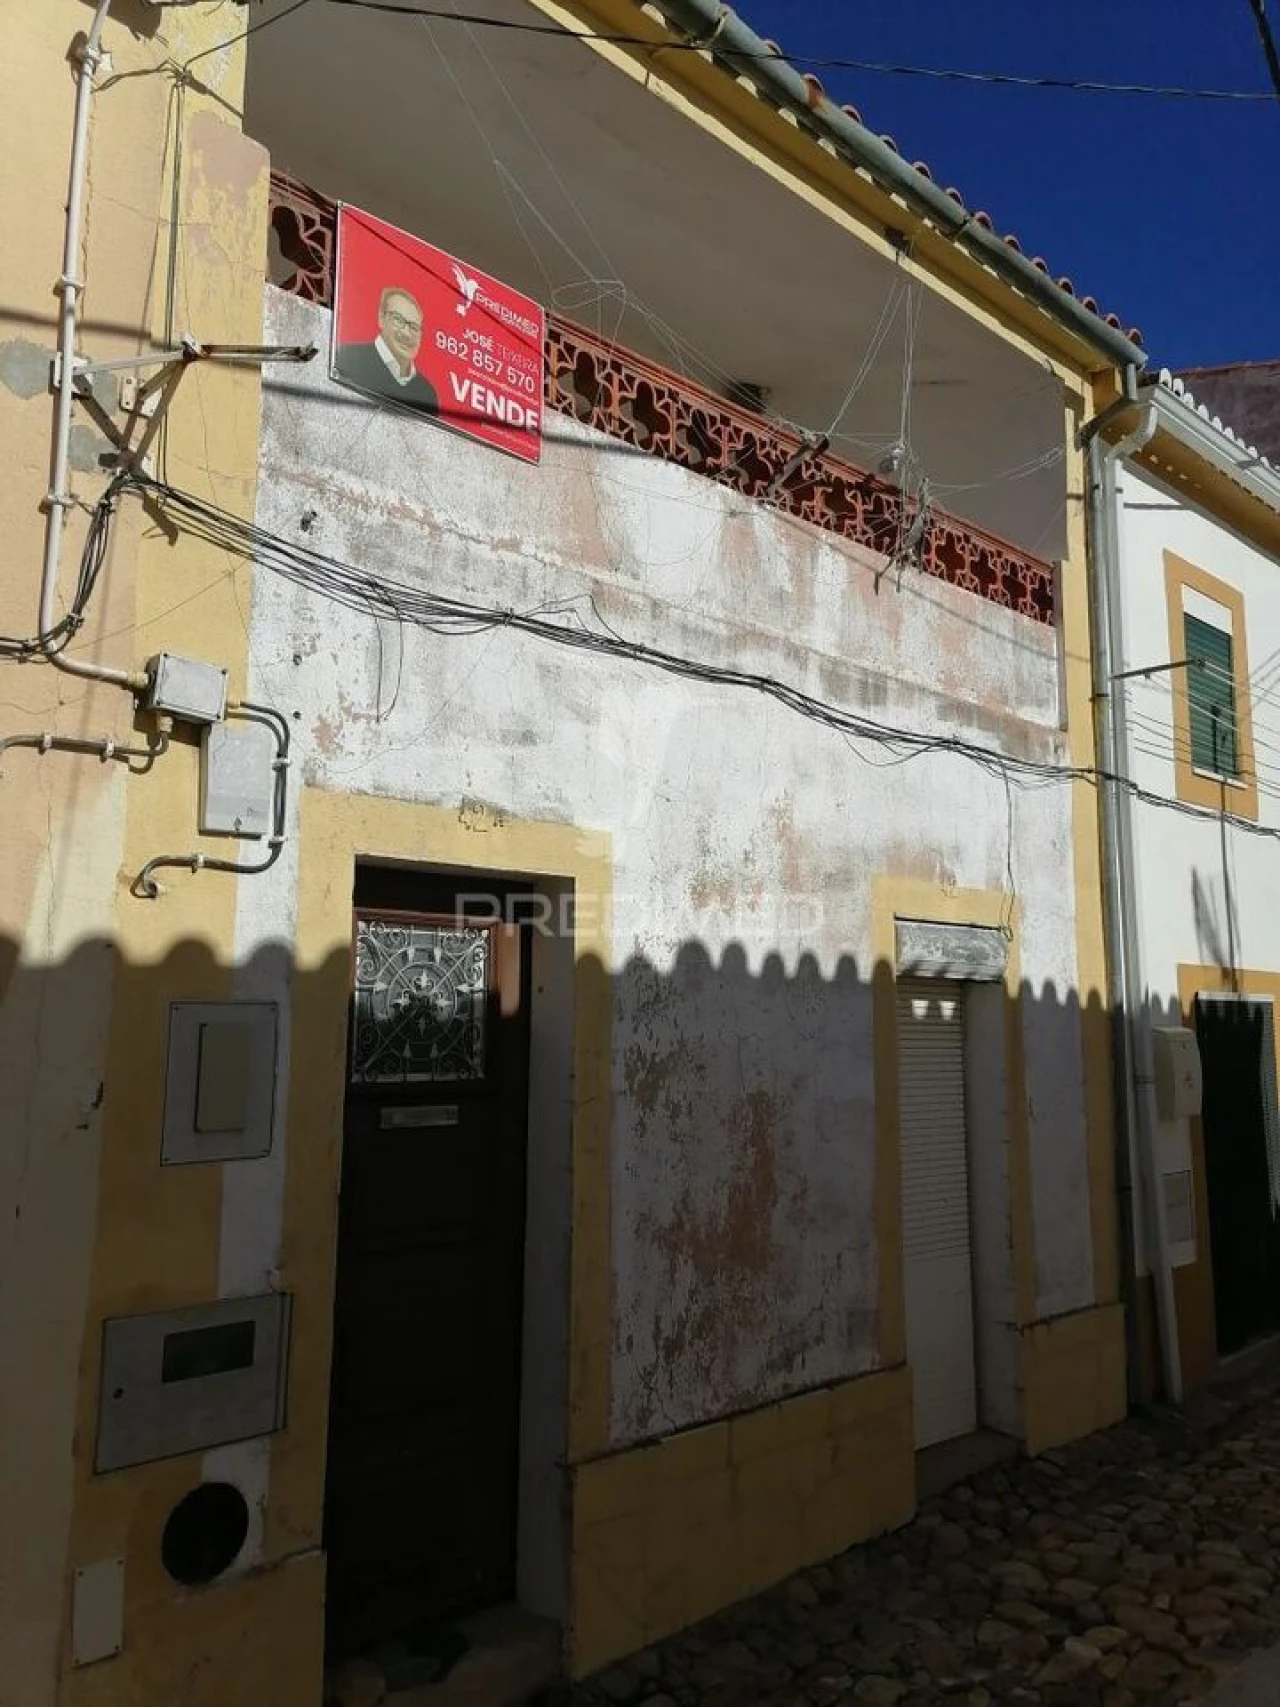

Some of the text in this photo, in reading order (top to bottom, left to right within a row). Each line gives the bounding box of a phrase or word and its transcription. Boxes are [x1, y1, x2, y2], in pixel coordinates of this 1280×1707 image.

[435, 330, 468, 361] 962
[472, 349, 503, 376] 857
[507, 365, 535, 393] 570
[462, 328, 494, 352] JOSÉ
[449, 371, 540, 434] VENDE
